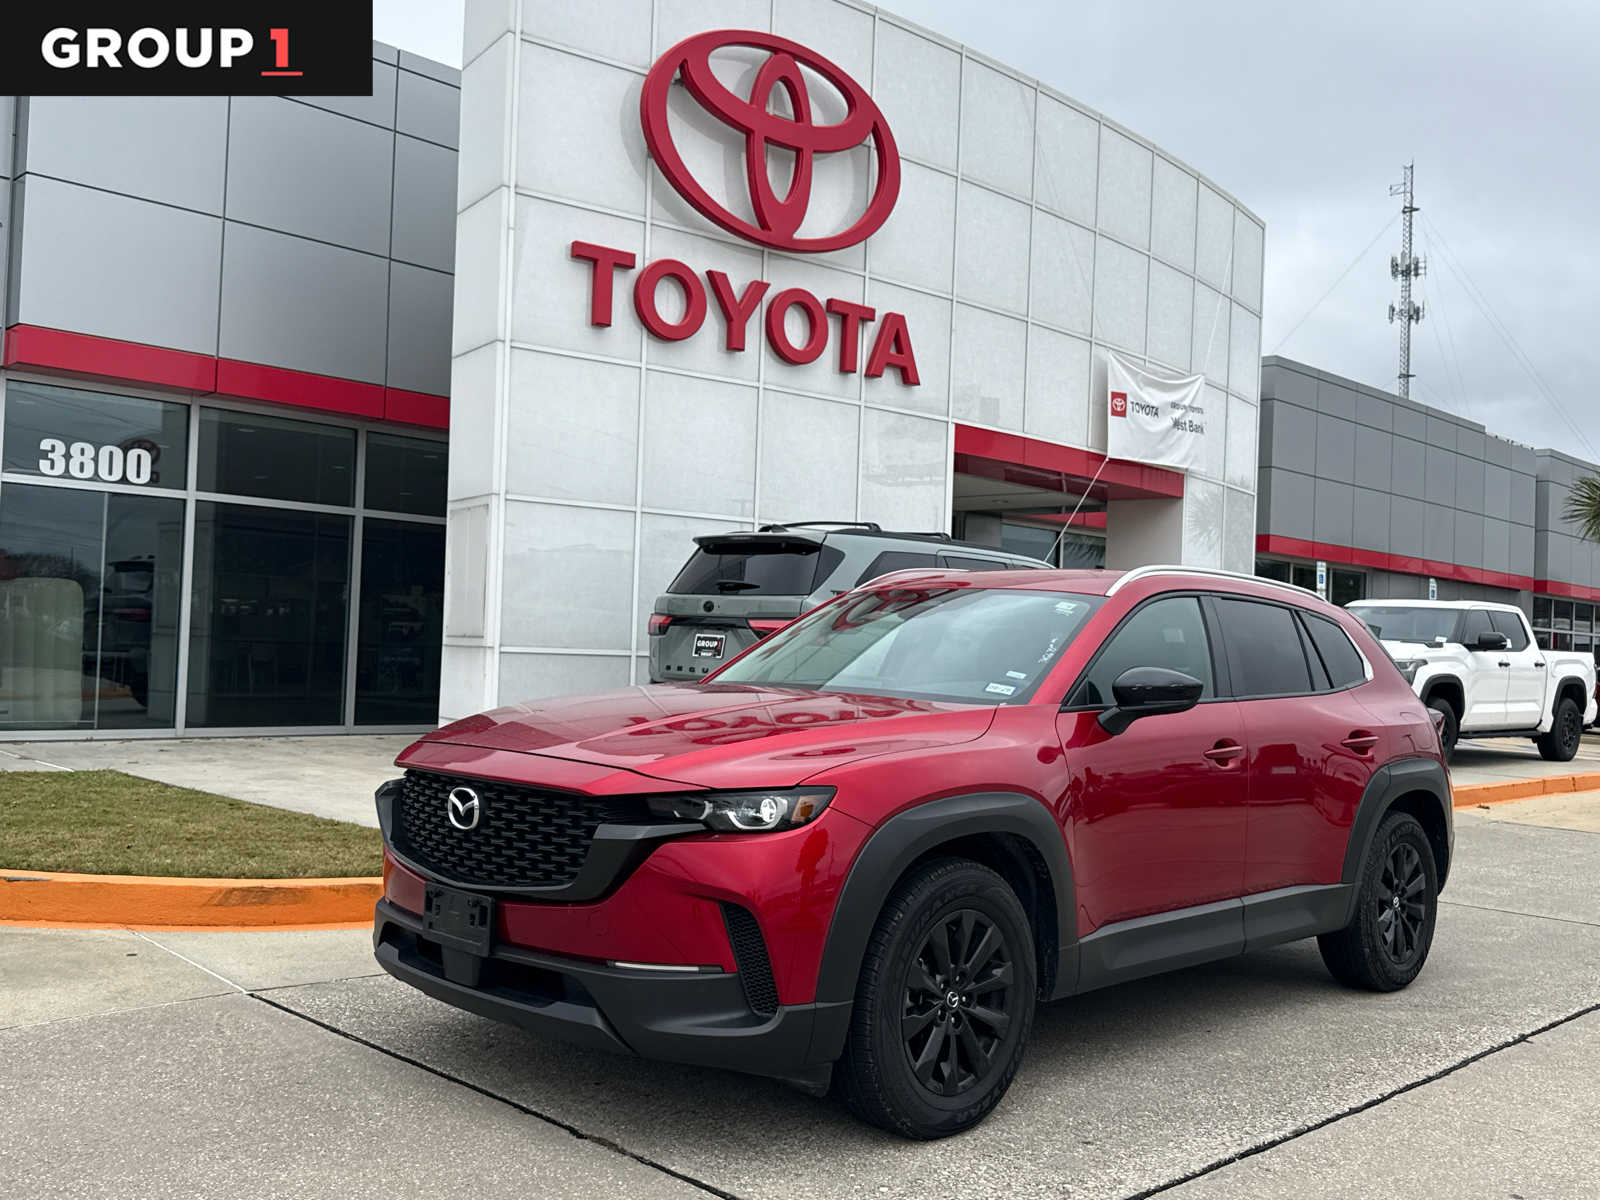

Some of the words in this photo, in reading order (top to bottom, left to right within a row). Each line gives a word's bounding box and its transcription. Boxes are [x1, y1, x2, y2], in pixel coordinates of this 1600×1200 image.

[571, 240, 921, 386] TOYOTA
[1130, 401, 1159, 418] TOYOTA
[39, 438, 152, 485] 3800
[697, 640, 718, 648] GROUP
